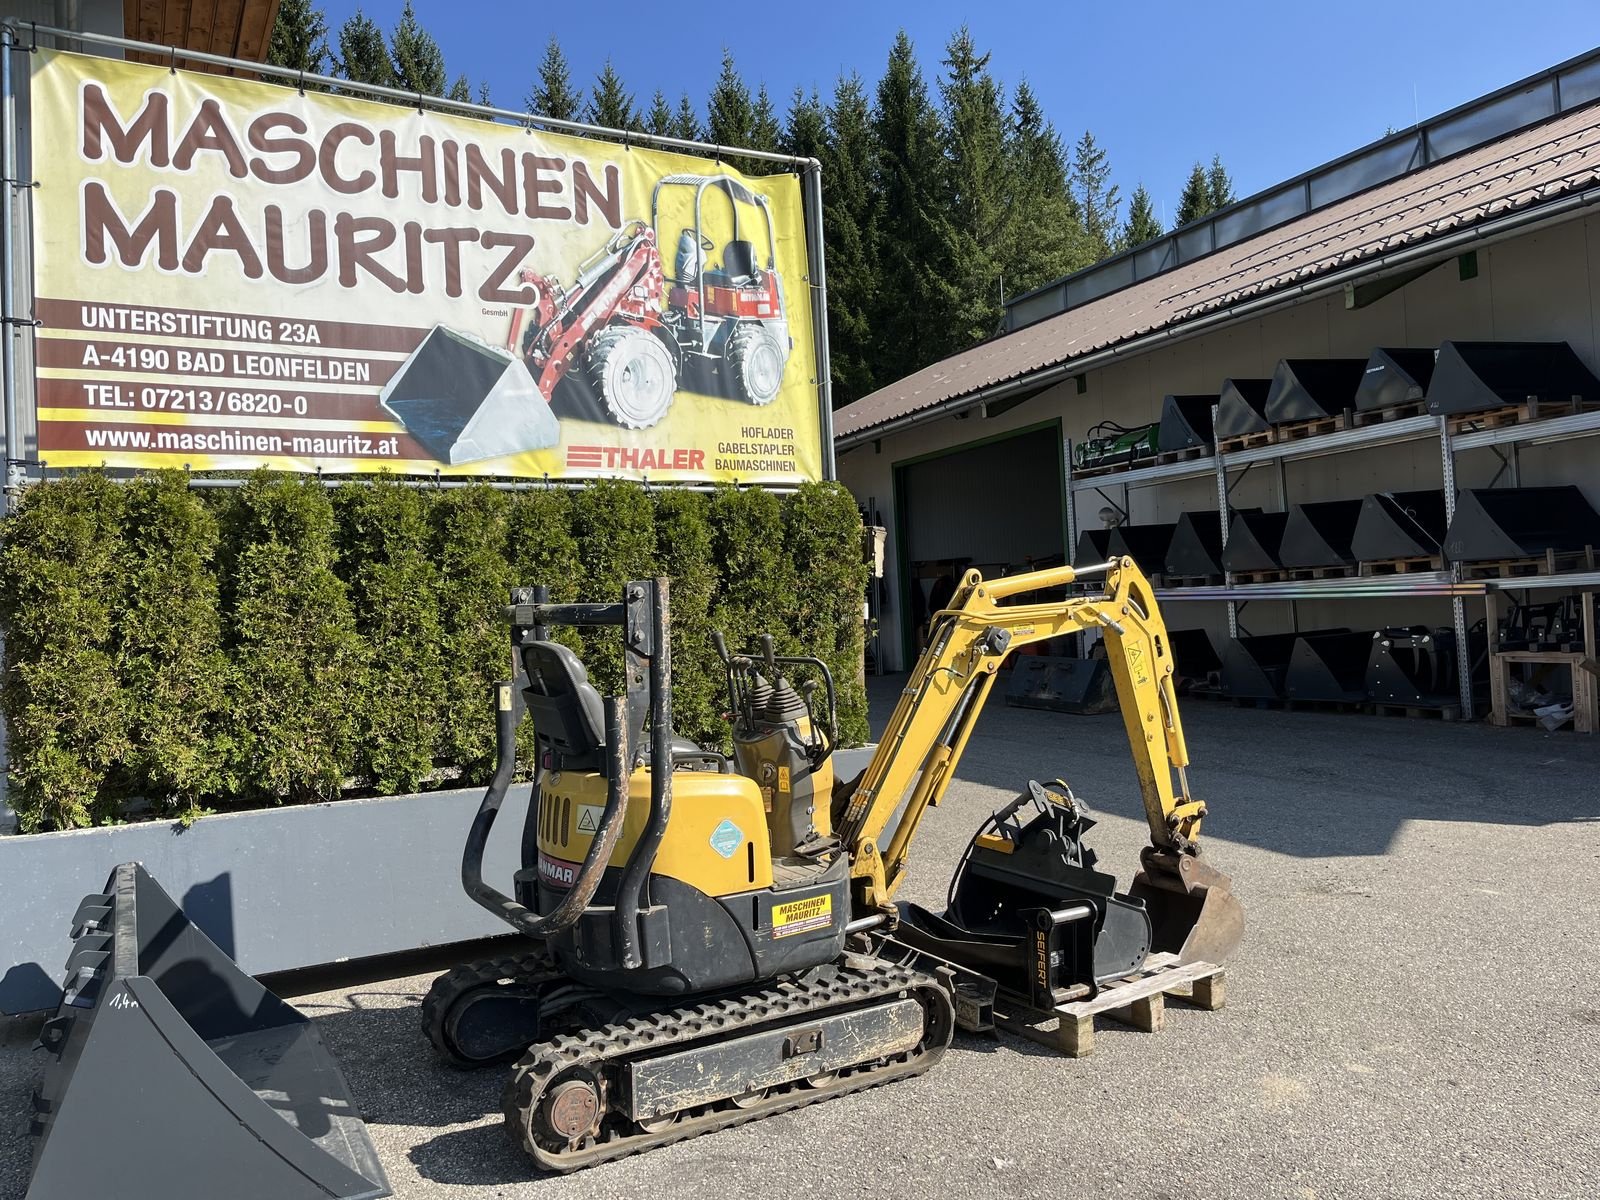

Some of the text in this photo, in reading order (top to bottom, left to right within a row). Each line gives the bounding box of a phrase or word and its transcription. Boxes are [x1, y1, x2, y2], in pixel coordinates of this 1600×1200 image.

[83, 84, 623, 229] MASCHINEN
[84, 182, 536, 305] MAURITZ
[481, 307, 509, 317] GesmbH
[81, 305, 321, 344] UNTERSTIFTUNG 23A
[82, 344, 370, 382] A-4190 BAD LEONFELDEN
[84, 384, 135, 408] TEL:
[85, 427, 399, 456] www.maschinen-mauritz.at
[741, 426, 794, 440] HOFLADER
[603, 446, 705, 470] THALER
[718, 442, 795, 456] GABELSTAPLER
[715, 458, 796, 473] BAUMASCHINEN
[779, 896, 826, 915] MASCHINEN
[785, 907, 821, 923] MAURITZ
[1036, 930, 1047, 989] SEIFERT
